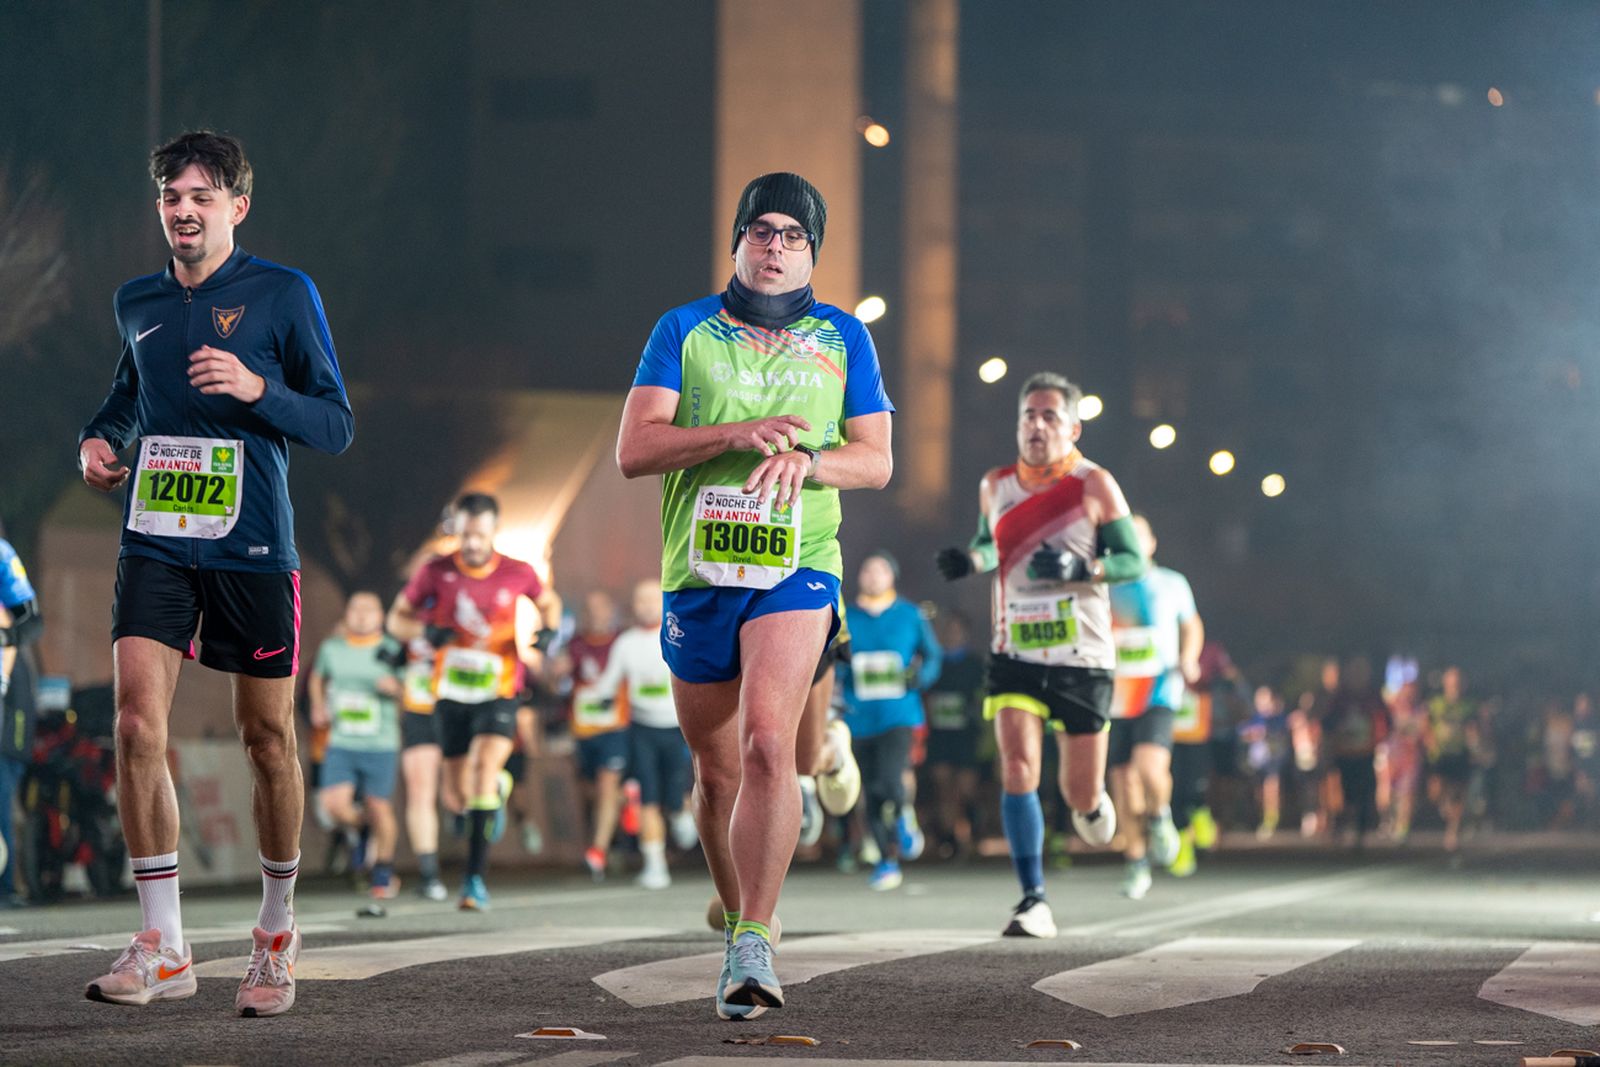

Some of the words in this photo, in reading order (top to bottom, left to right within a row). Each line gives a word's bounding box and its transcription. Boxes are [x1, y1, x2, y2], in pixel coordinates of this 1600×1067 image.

[738, 368, 824, 388] SAKATA
[160, 448, 190, 459] NOCHE
[190, 449, 202, 460] DE
[147, 459, 168, 470] SAN
[168, 460, 202, 472] ANTÓN
[149, 472, 225, 505] 12072
[173, 504, 194, 512] Carlos
[715, 498, 746, 509] NOCHE
[748, 500, 761, 510] DE
[703, 509, 722, 520] SAN
[724, 510, 761, 523] ANTÓN
[702, 522, 788, 556] 13066
[732, 555, 752, 563] David
[1020, 620, 1067, 642] 8403
